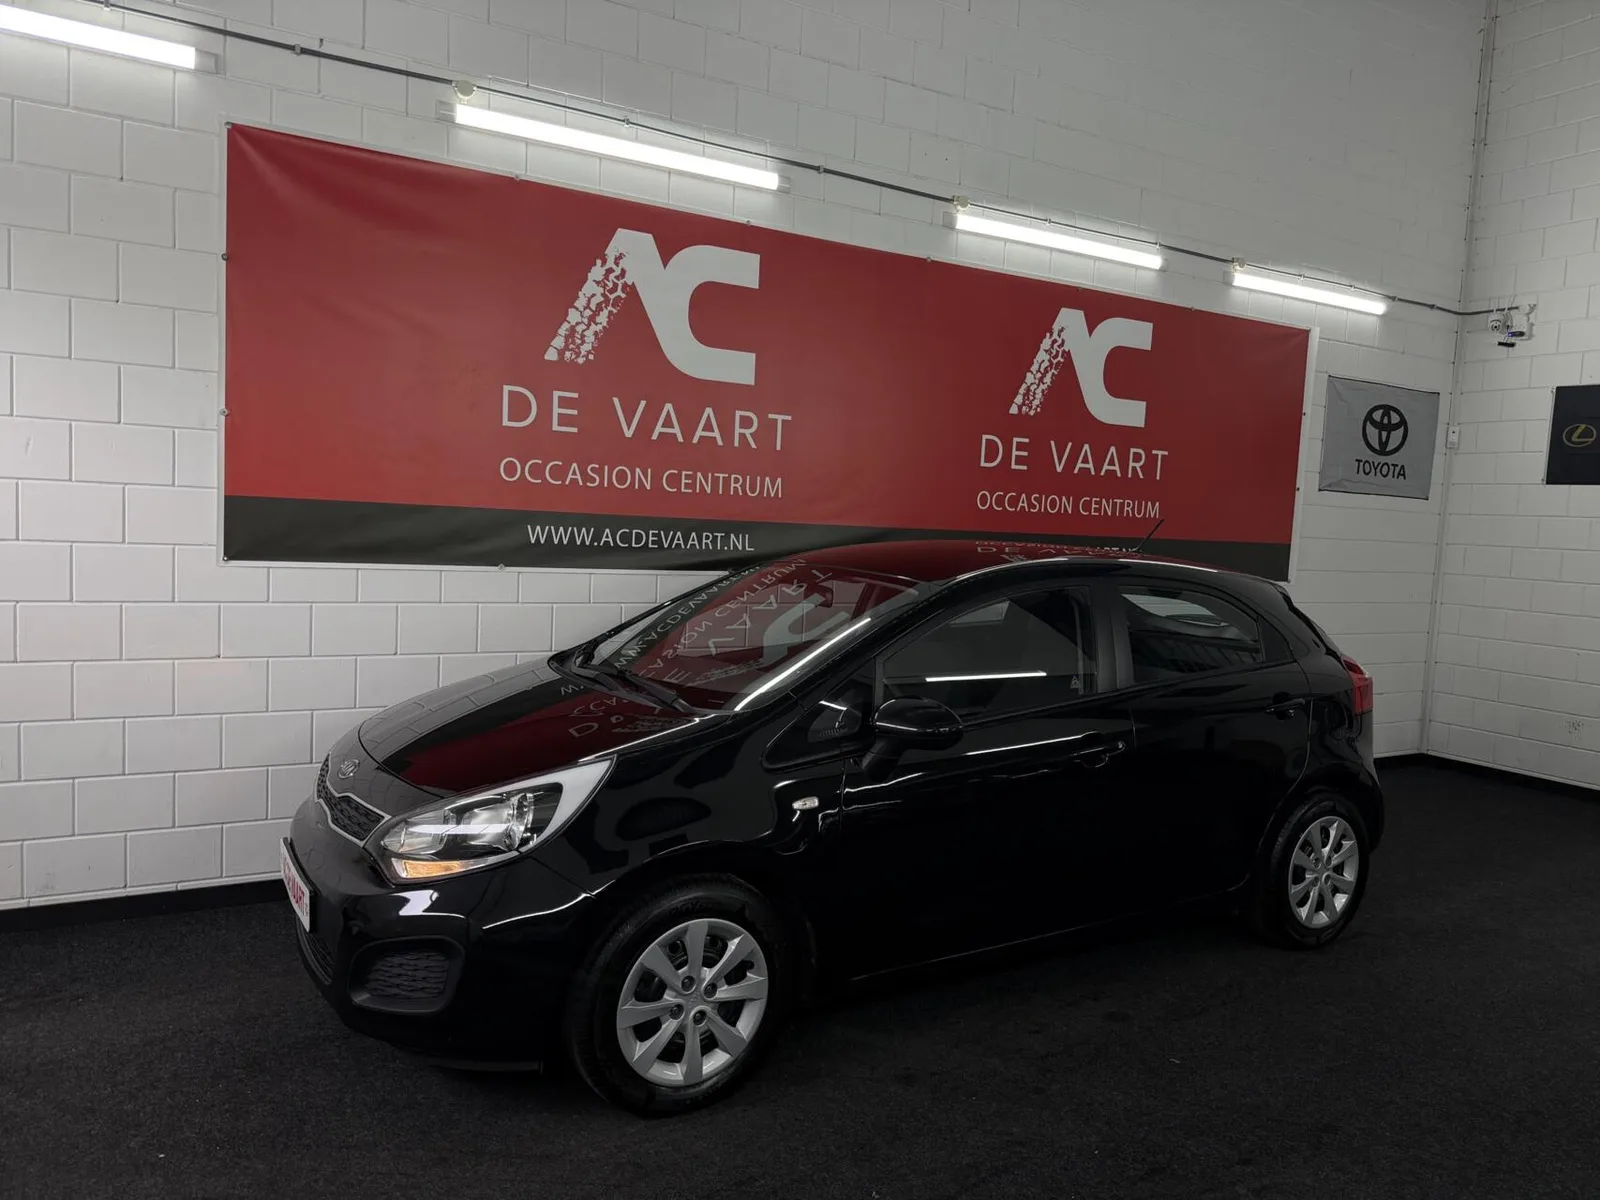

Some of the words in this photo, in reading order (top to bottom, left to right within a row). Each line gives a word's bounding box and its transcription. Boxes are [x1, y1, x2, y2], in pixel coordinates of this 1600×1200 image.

[544, 228, 760, 385] AC
[1009, 307, 1153, 427] AC
[502, 384, 579, 433] DE
[612, 397, 792, 450] VAART
[500, 457, 651, 490] OCCASION
[662, 470, 782, 498] CENTRUM
[980, 434, 1029, 470] DE
[1050, 440, 1168, 480] VAART
[1355, 459, 1406, 480] TOYOTA
[977, 491, 1073, 514] OCCASION
[1079, 497, 1160, 518] CENTRUM
[527, 524, 754, 551] WWW.ACDEVAART.NL
